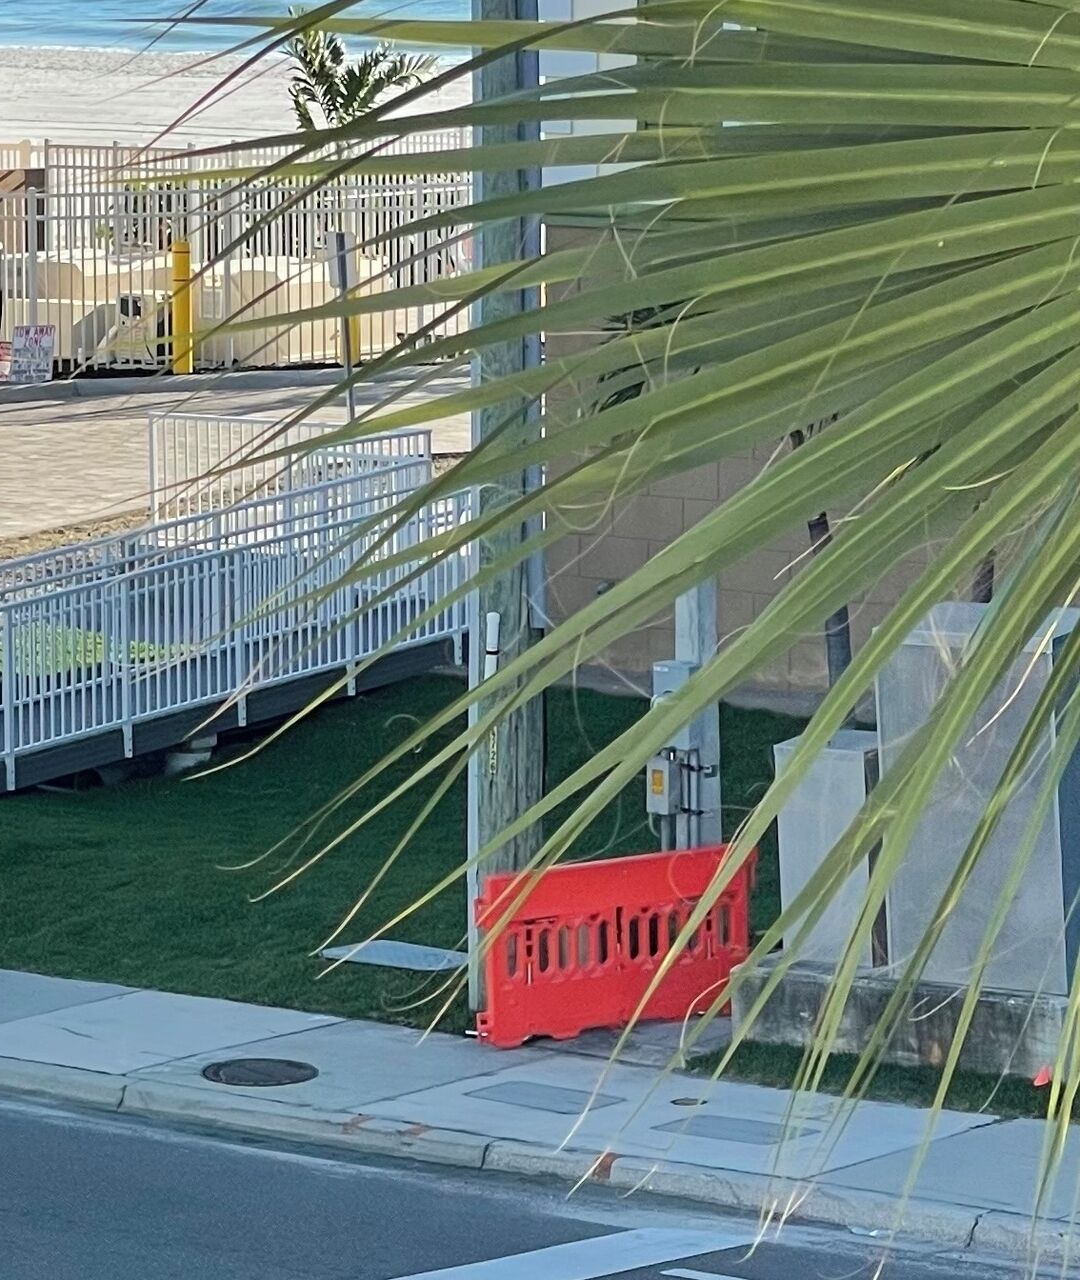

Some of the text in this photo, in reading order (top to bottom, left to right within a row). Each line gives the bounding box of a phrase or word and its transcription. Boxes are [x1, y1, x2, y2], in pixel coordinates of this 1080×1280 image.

[16, 326, 53, 337] TOW AWAY
[24, 336, 42, 348] ZONE
